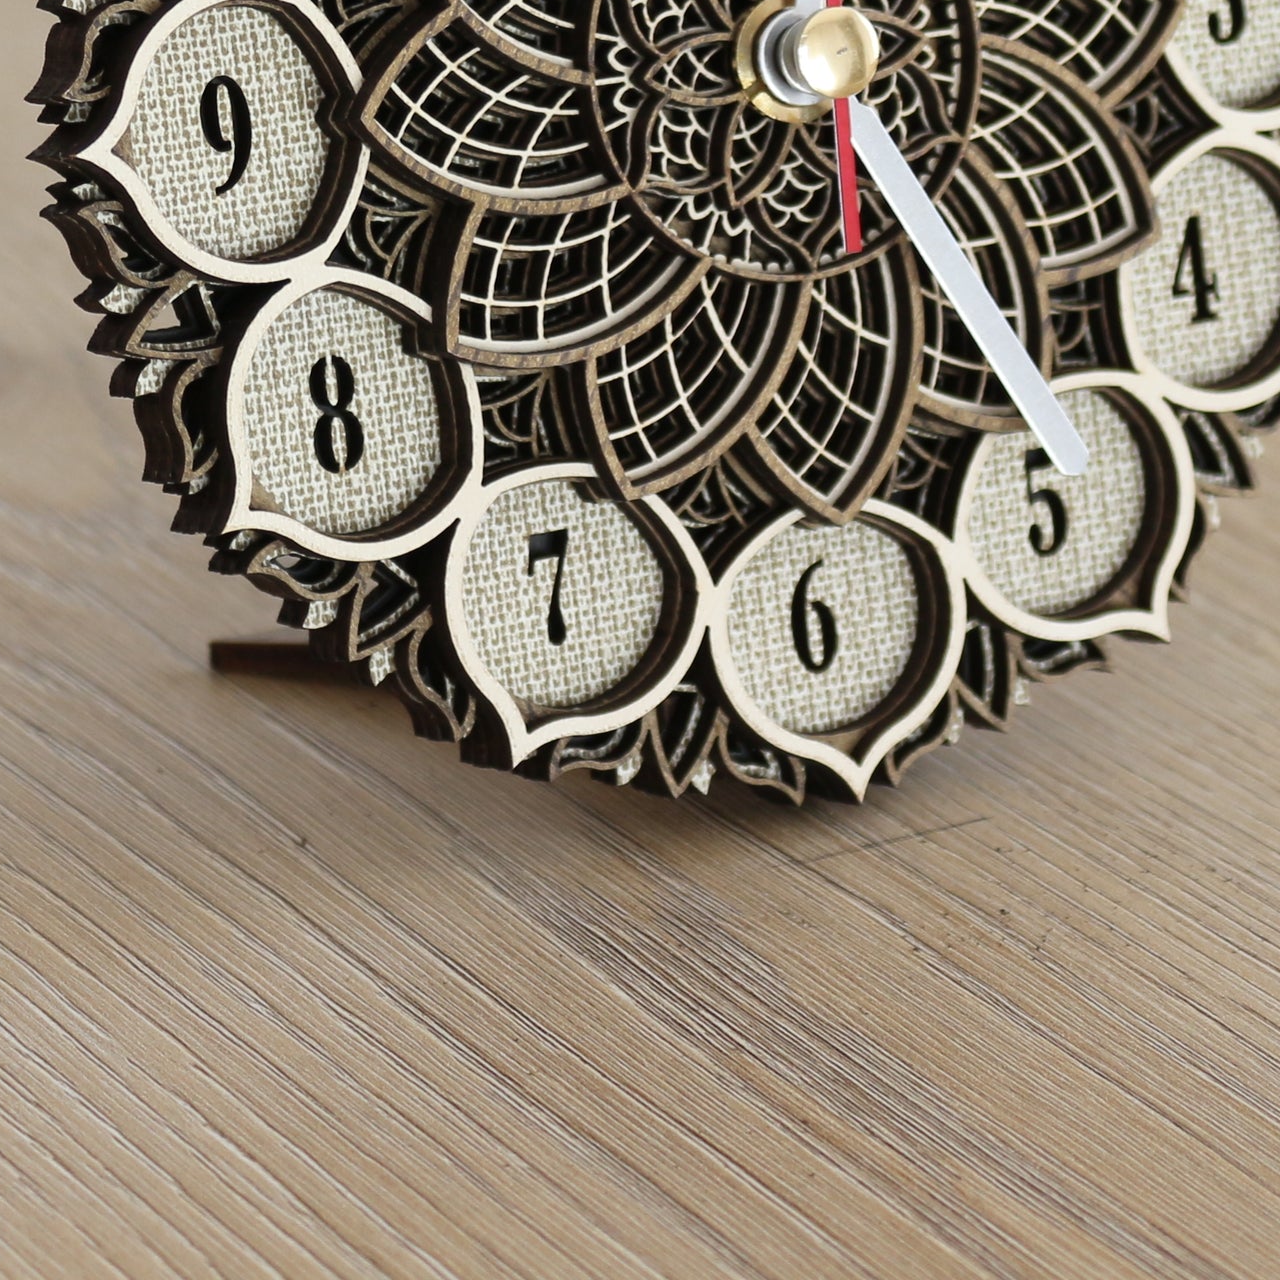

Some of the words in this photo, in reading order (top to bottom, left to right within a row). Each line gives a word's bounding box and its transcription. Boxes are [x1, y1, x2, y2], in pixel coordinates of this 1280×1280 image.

[200, 76, 251, 195] 9
[1172, 216, 1218, 322] 4
[309, 355, 363, 473] 8
[1024, 448, 1067, 556] 5
[528, 529, 568, 644] 7
[791, 560, 837, 672] 6
